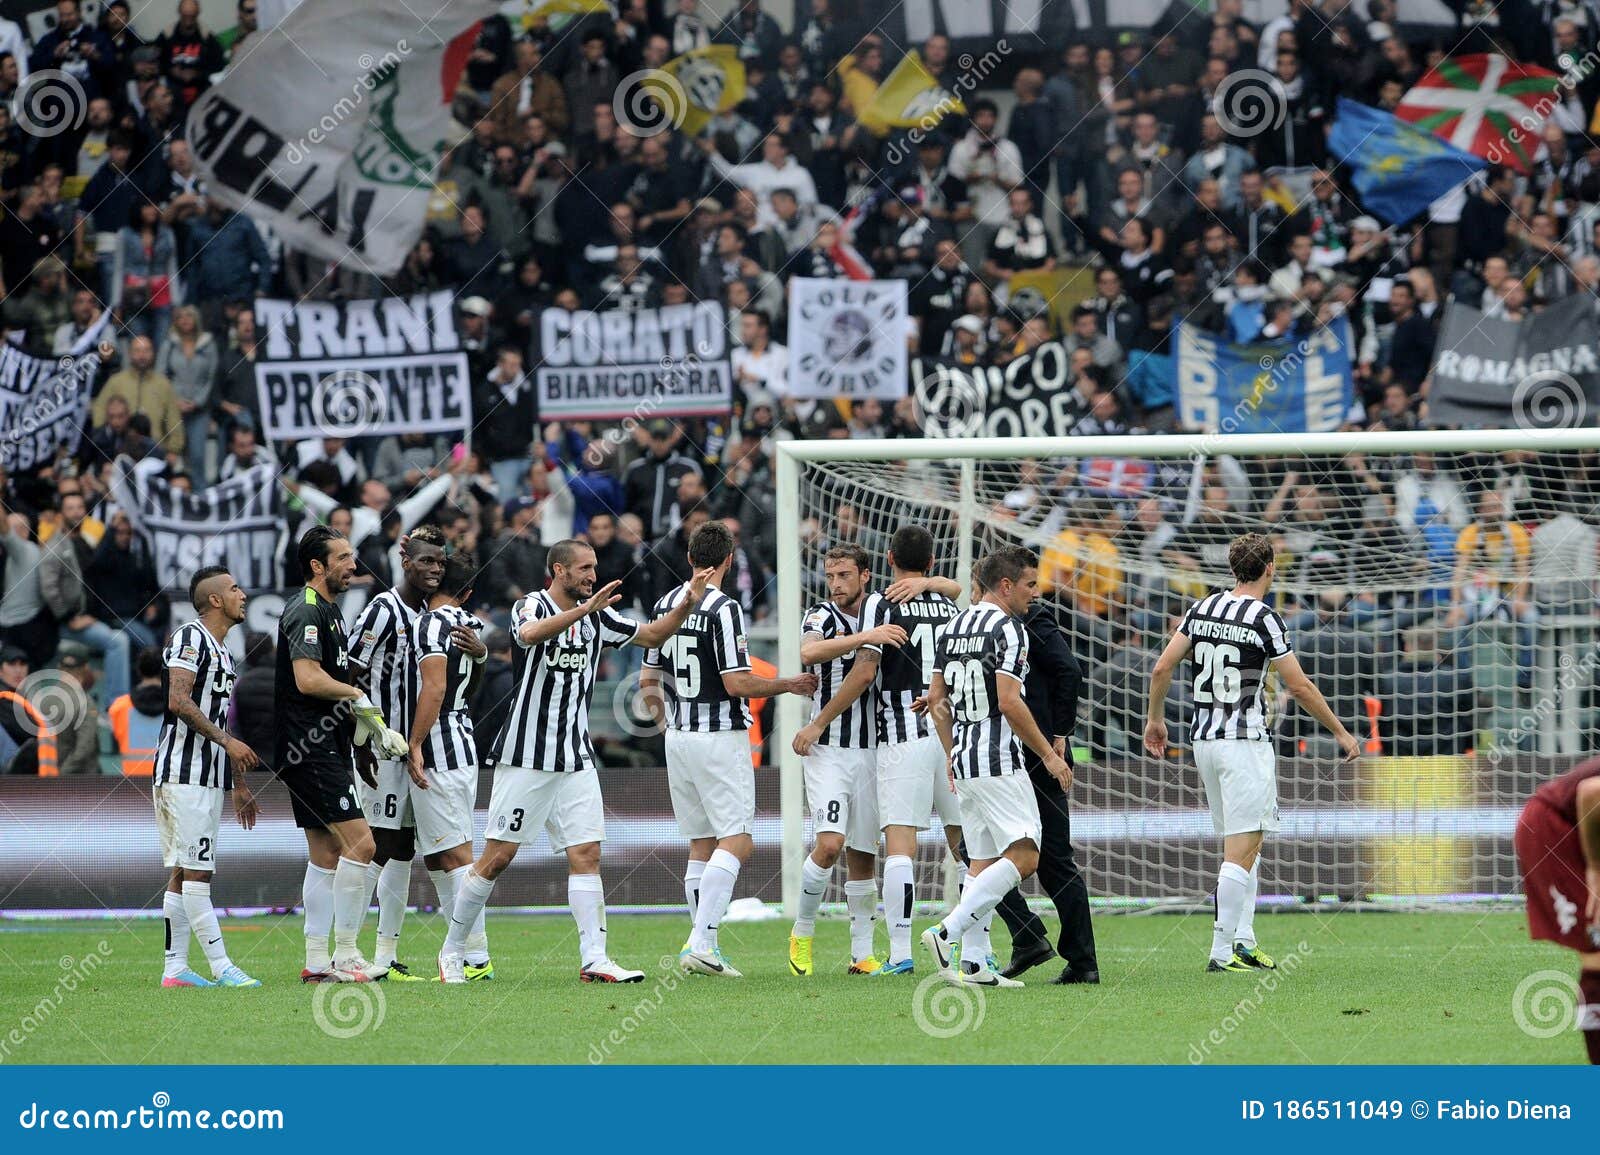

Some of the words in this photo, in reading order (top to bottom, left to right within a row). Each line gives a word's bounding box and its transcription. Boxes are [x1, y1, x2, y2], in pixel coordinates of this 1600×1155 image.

[801, 287, 897, 321] COLPO
[254, 289, 460, 361] TRANI
[541, 299, 726, 367] CORATO
[800, 353, 897, 393] GOBBO
[1436, 344, 1600, 386] ROMAGNA
[546, 648, 587, 673] Jeep
[661, 634, 701, 698] 15
[1193, 641, 1241, 704] 26
[944, 659, 990, 721] 20
[349, 784, 361, 809] 1
[384, 793, 397, 818] 6
[827, 800, 840, 823] 8
[510, 807, 525, 832] 3
